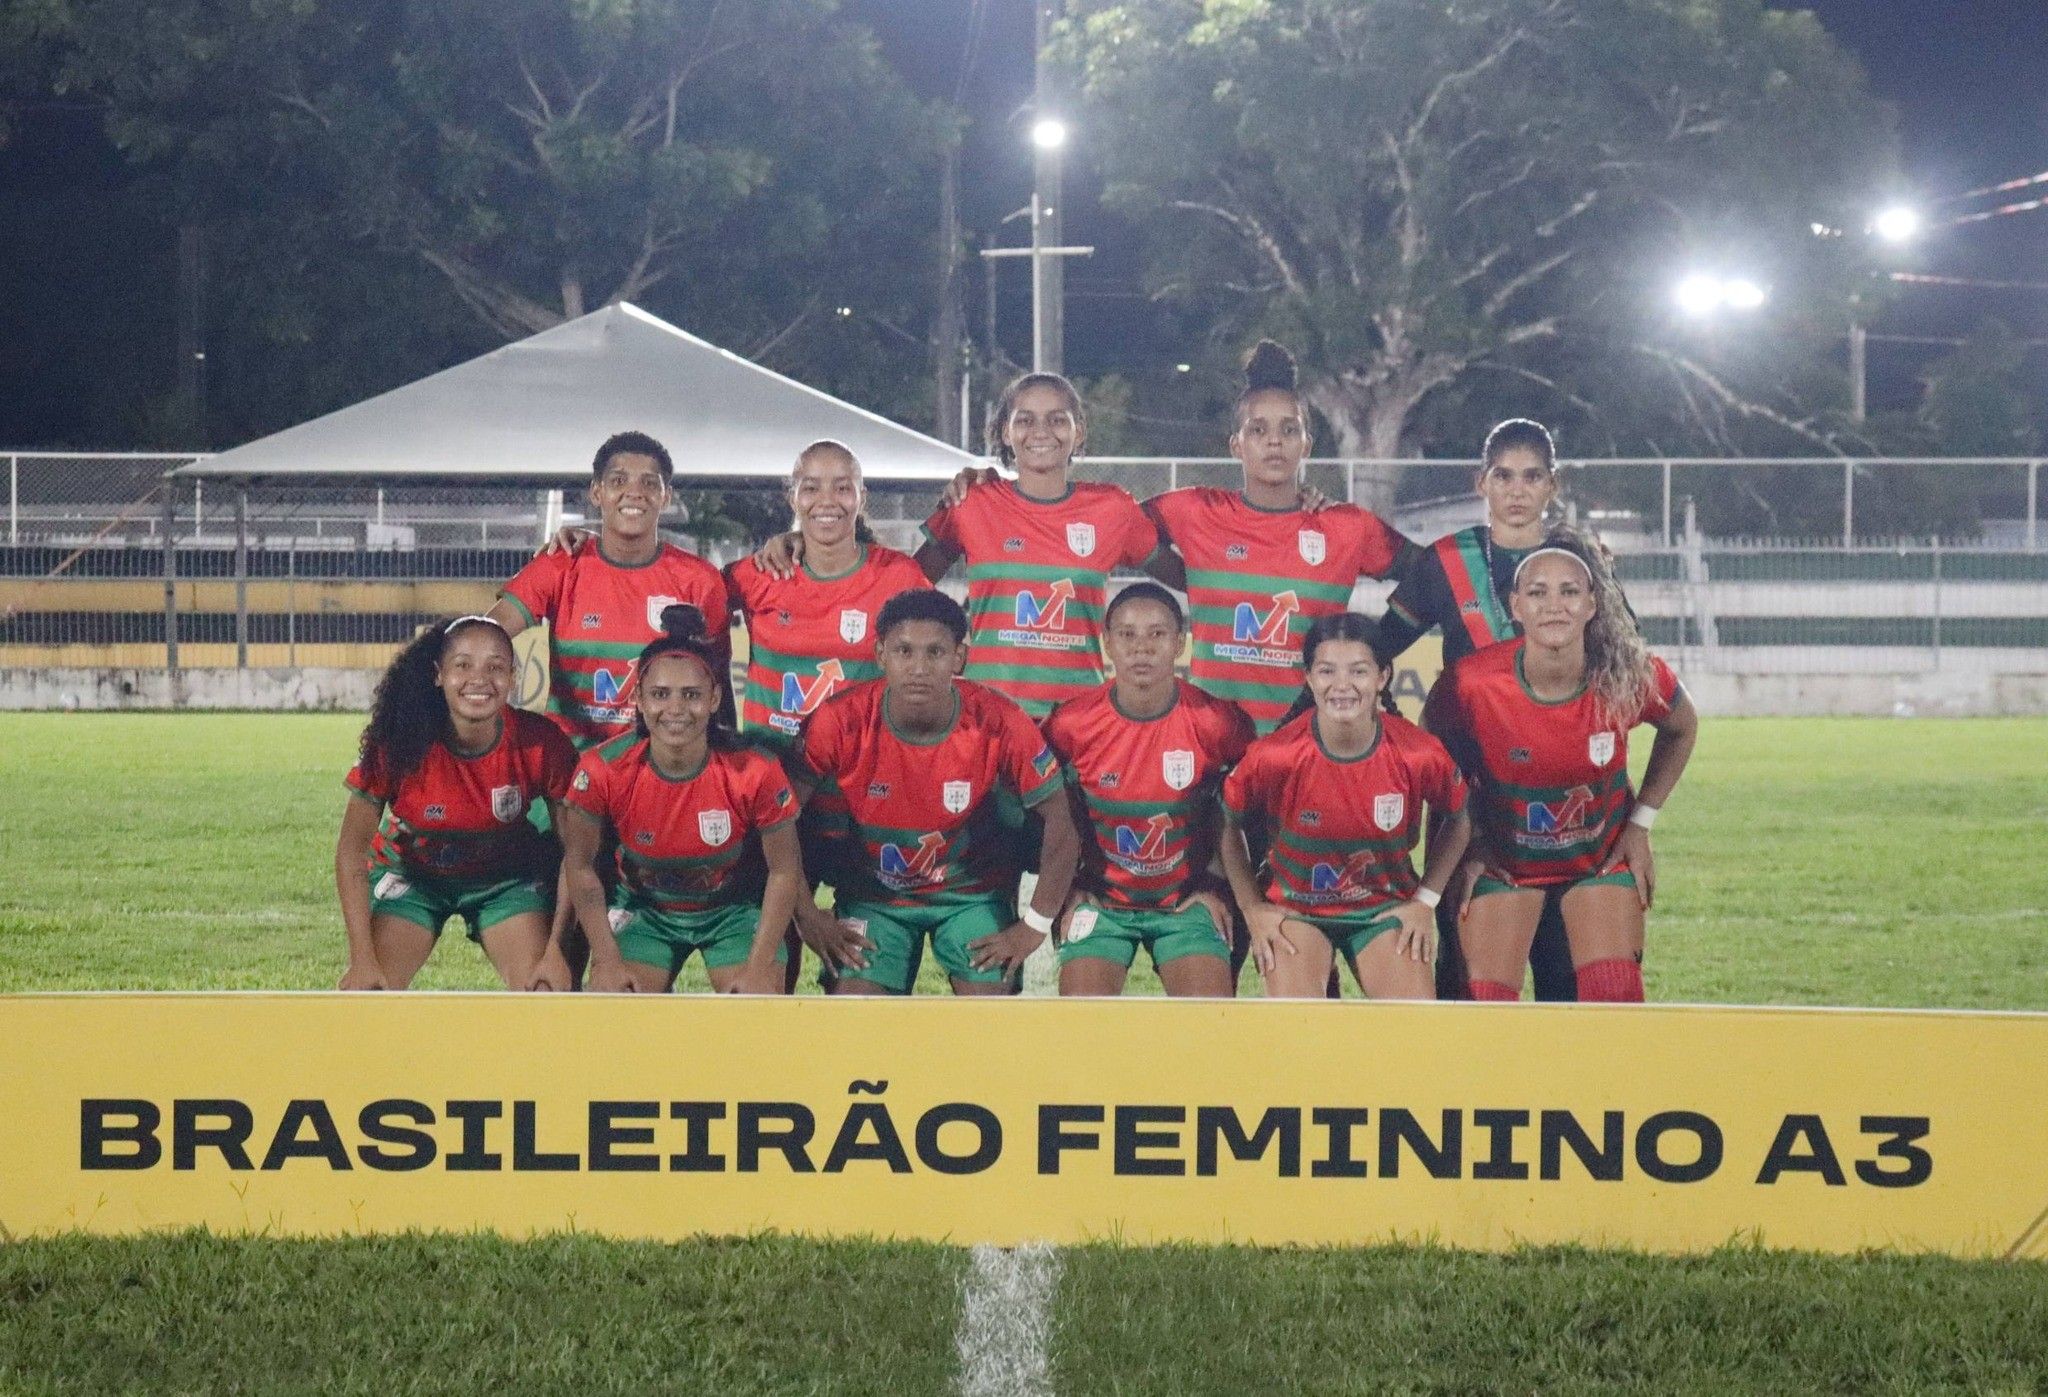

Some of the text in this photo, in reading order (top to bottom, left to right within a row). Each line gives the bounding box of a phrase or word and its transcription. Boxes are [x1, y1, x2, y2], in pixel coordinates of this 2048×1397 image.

[1215, 644, 1303, 663] MEGA NORT
[81, 1080, 1933, 1188] BRASILEIRÃO FEMININO A3
